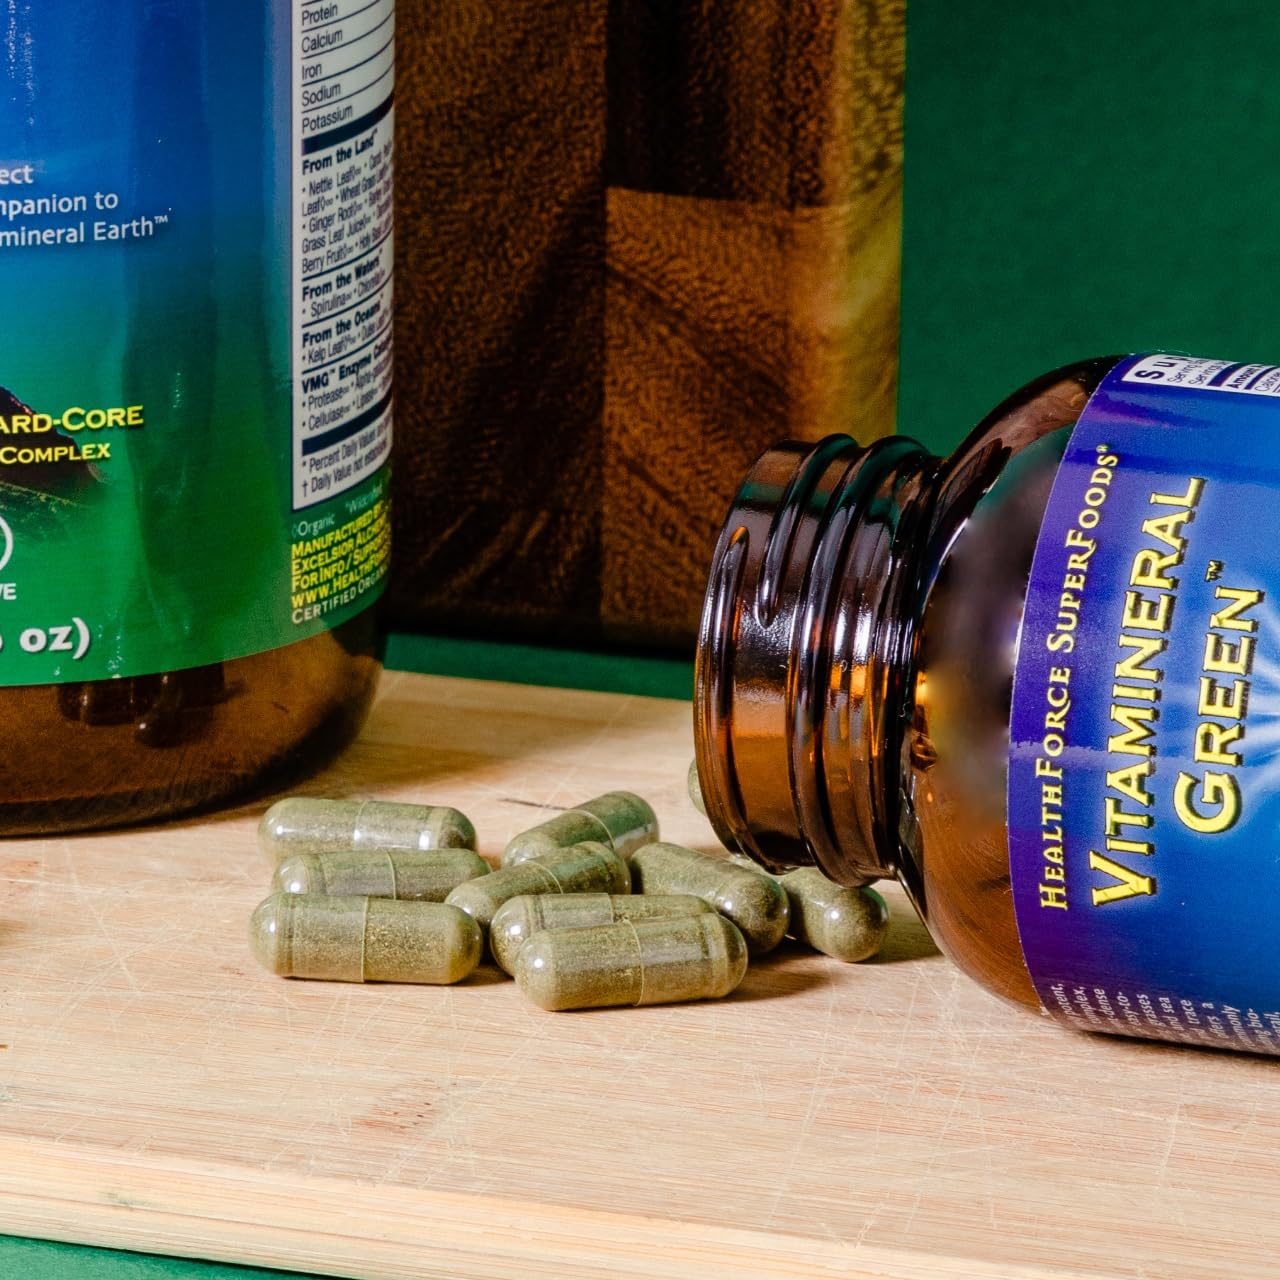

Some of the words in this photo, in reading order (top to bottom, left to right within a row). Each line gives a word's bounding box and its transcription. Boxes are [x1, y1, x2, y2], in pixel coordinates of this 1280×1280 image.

[302, 2, 338, 26] Protein
[302, 28, 343, 53] Calcium
[302, 62, 322, 81] Iron
[302, 81, 341, 107] Sodium
[302, 103, 353, 134] Potassium
[302, 155, 332, 175] From
[337, 144, 352, 163] the
[88, 190, 119, 210] to
[302, 234, 325, 254] Grass
[302, 256, 325, 274] Berry
[302, 281, 332, 302] From
[336, 271, 351, 290] the
[303, 326, 332, 348] From
[336, 317, 352, 337] the
[308, 346, 326, 365] Kelp
[339, 352, 372, 381] Enzyme
[292, 538, 354, 576] EXCELSIOR
[292, 571, 318, 592] FOR
[320, 560, 344, 582] INFO
[292, 585, 356, 624] CERTIFIED
[20, 617, 91, 659] oz)
[1090, 477, 1206, 907] VITAMINERAL
